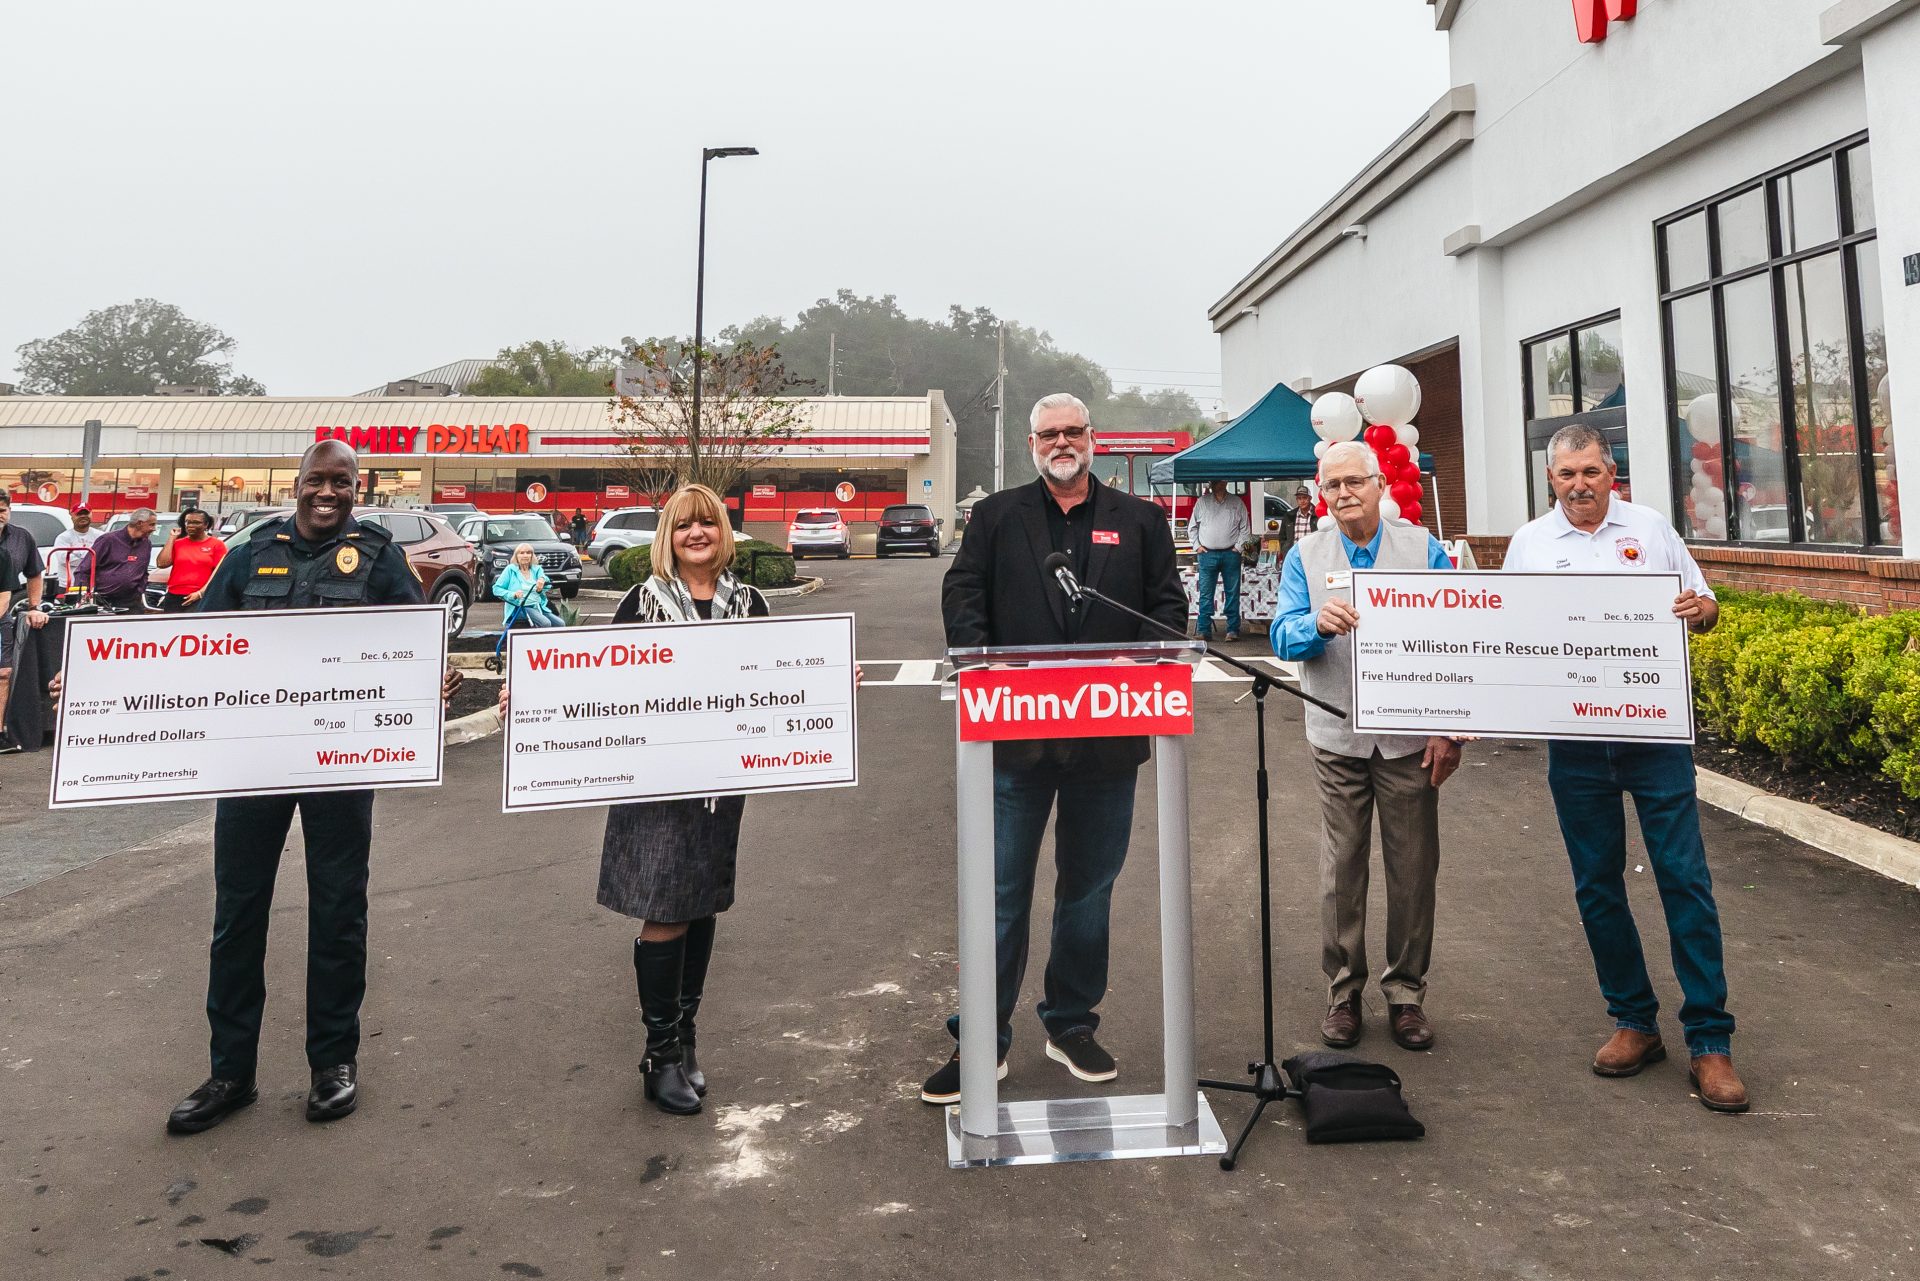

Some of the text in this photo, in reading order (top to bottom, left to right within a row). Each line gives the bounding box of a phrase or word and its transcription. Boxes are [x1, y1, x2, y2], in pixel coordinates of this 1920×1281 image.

[315, 423, 529, 453] FAMILY DOLLAR
[1367, 588, 1503, 610] Winn Dixie
[1604, 613, 1622, 621] Dec.
[1624, 613, 1632, 622] 6,
[1633, 613, 1654, 621] 2025
[86, 633, 250, 661] Winn Dixie
[361, 652, 380, 660] Dec.
[382, 651, 391, 661] 6,
[392, 650, 414, 659] 2025
[1402, 639, 1659, 659] Williston Fire Rescue Department
[526, 642, 673, 671] Winn Dixie
[776, 659, 794, 668] Dec.
[795, 659, 804, 668] 6,
[805, 658, 825, 666] 2025
[1361, 671, 1473, 683] Five Hundred Dollars
[1623, 671, 1660, 685] $500
[123, 685, 386, 711] Williston Police Department
[562, 689, 805, 719] Williston Middle High School
[962, 681, 1188, 723] Winn Dixie
[1377, 706, 1471, 718] Community Partnership
[1573, 702, 1667, 719] Winn Dixie
[374, 712, 413, 727] $500
[786, 717, 834, 733] $1,000
[67, 729, 206, 746] Five Hundred Dollars
[515, 735, 647, 753] One Thousand Dollars
[316, 747, 416, 766] Winn Dixie
[740, 750, 832, 769] Winn Dixie
[82, 768, 198, 783] Community Partnership
[530, 773, 635, 789] Community Partnership
